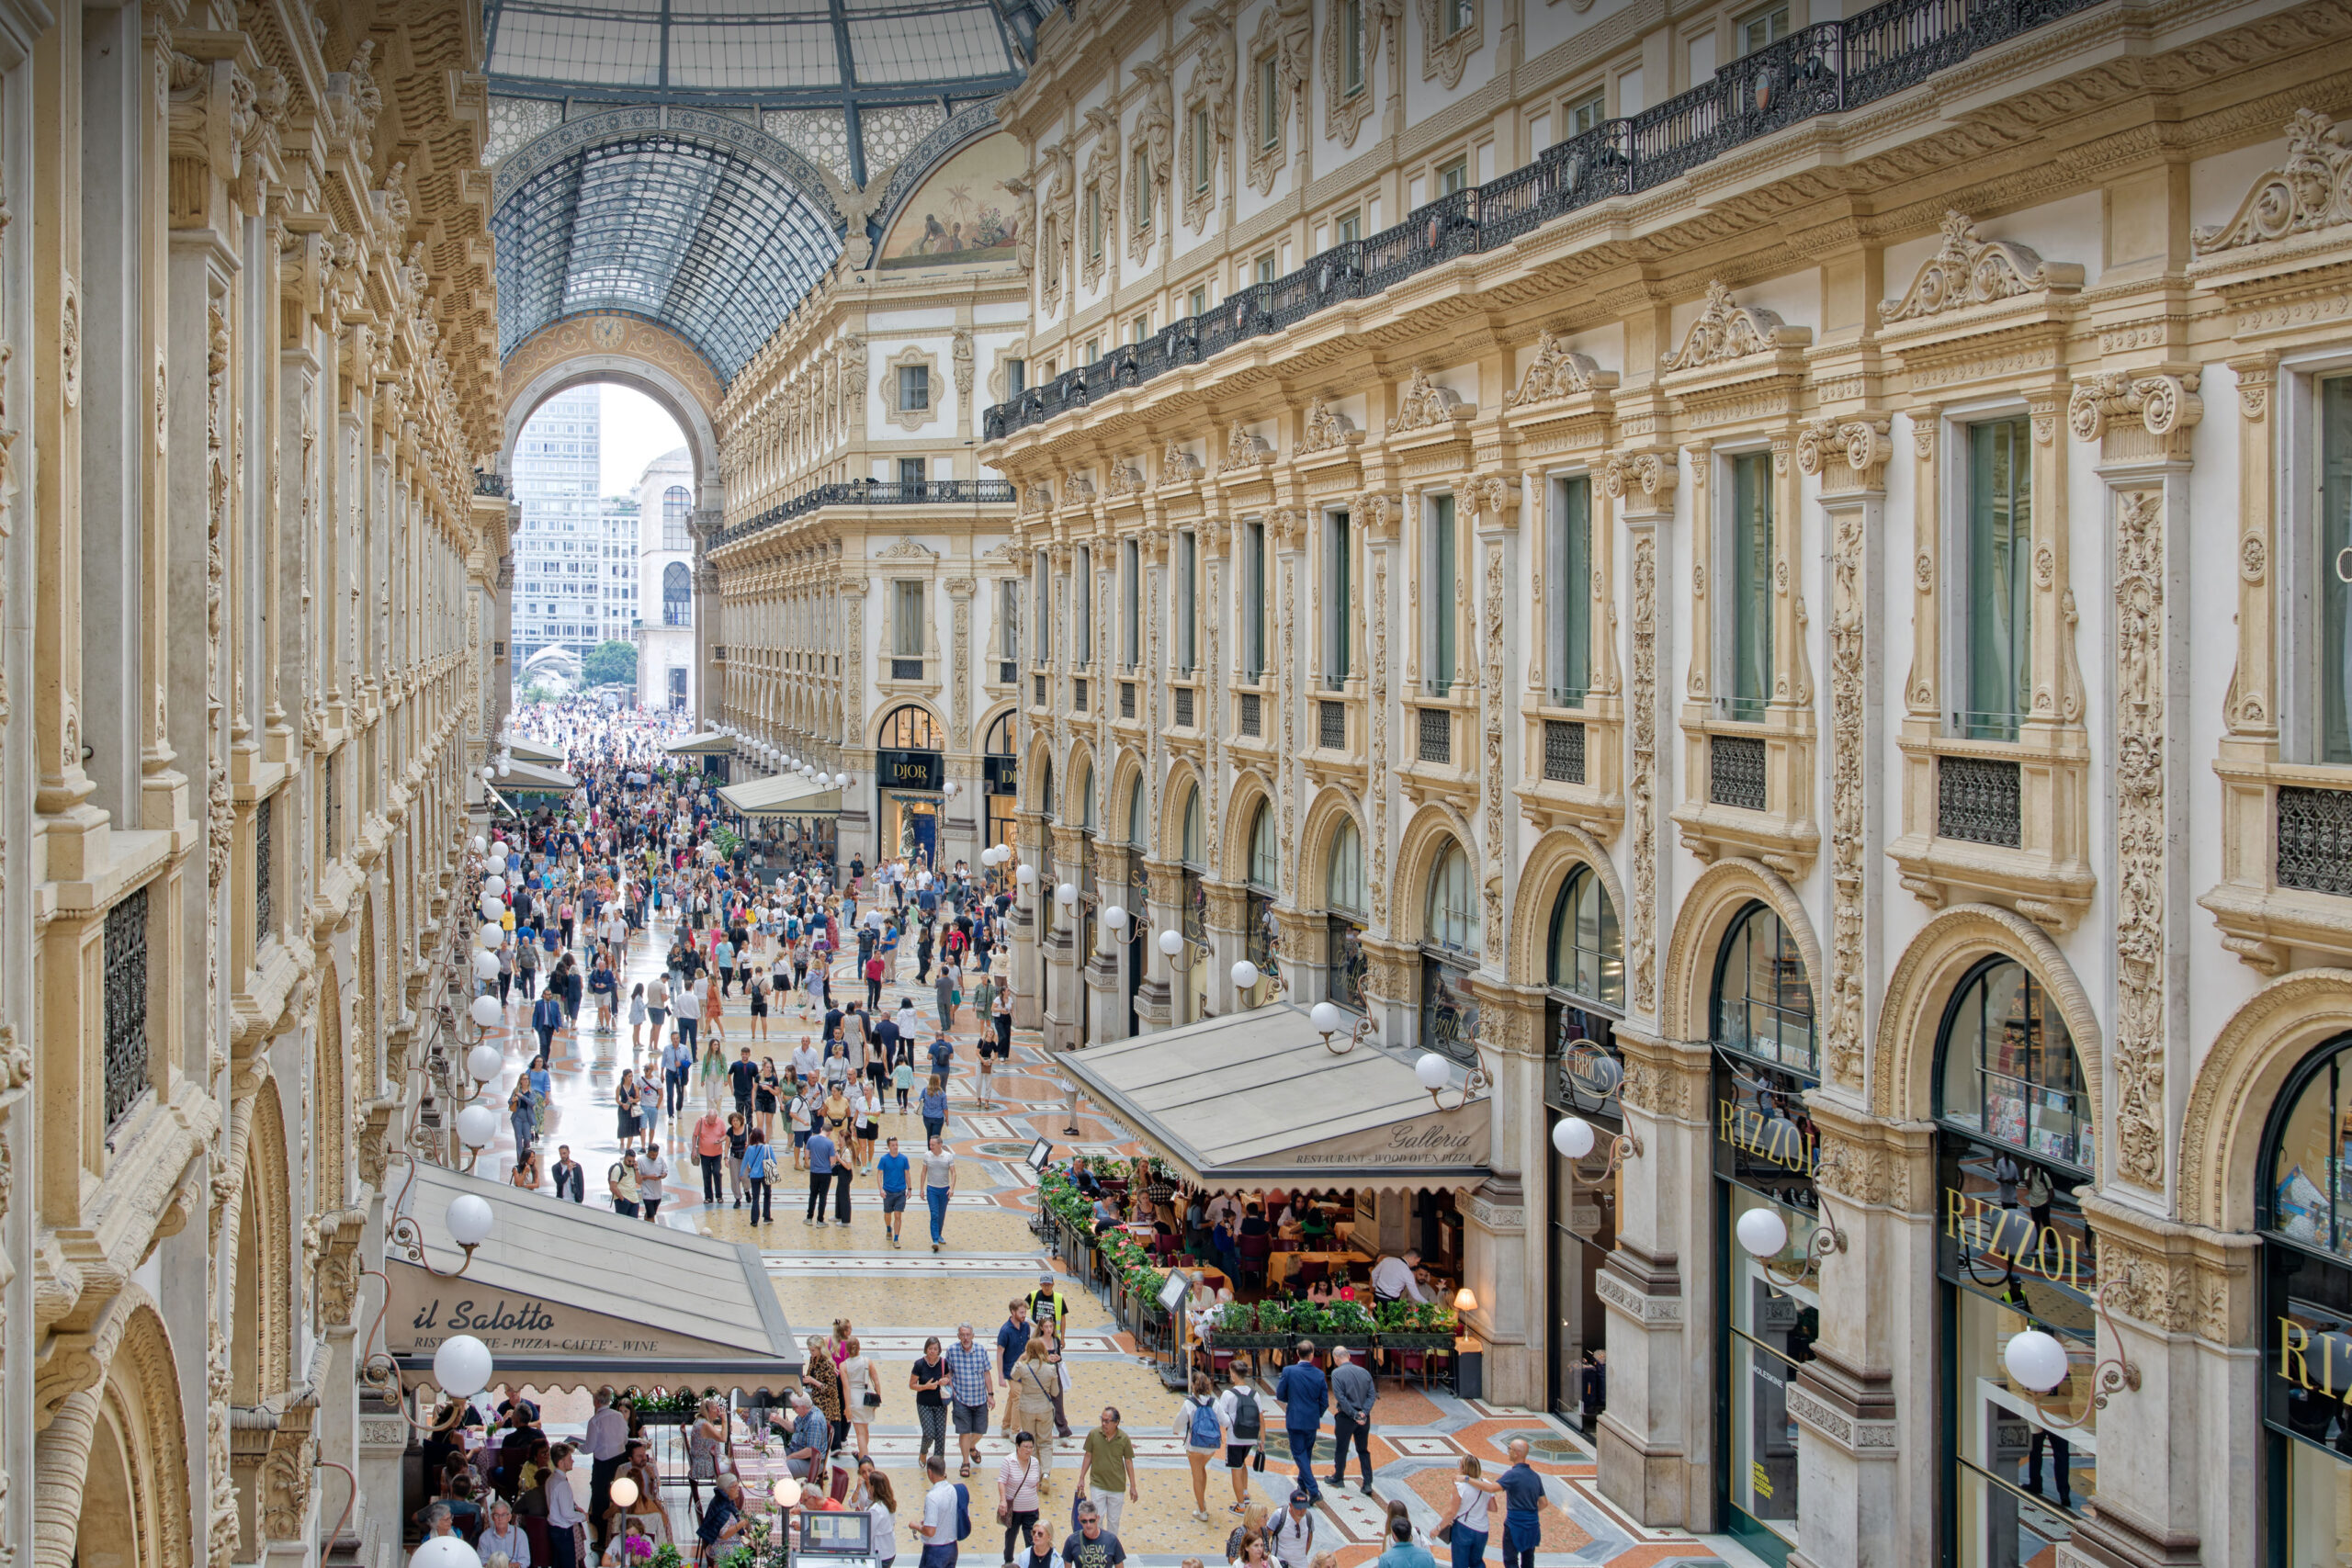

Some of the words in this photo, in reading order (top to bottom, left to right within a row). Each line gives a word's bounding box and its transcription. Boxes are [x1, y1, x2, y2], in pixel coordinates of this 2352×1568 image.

[893, 763, 928, 779] DIOR
[1387, 1124, 1472, 1149] Galleria
[1296, 1154, 1365, 1164] RESTAURANT
[1374, 1154, 1408, 1163] WOOD
[1408, 1154, 1439, 1163] OVEN
[1441, 1153, 1473, 1163] PIZZA
[413, 1299, 439, 1329] il
[447, 1300, 555, 1331] Salotto
[414, 1337, 501, 1348] RISTTE
[511, 1337, 550, 1349] PIZZA
[622, 1340, 660, 1352] WINE
[2277, 1315, 2352, 1406] RI
[1083, 1544, 1106, 1554] NEW
